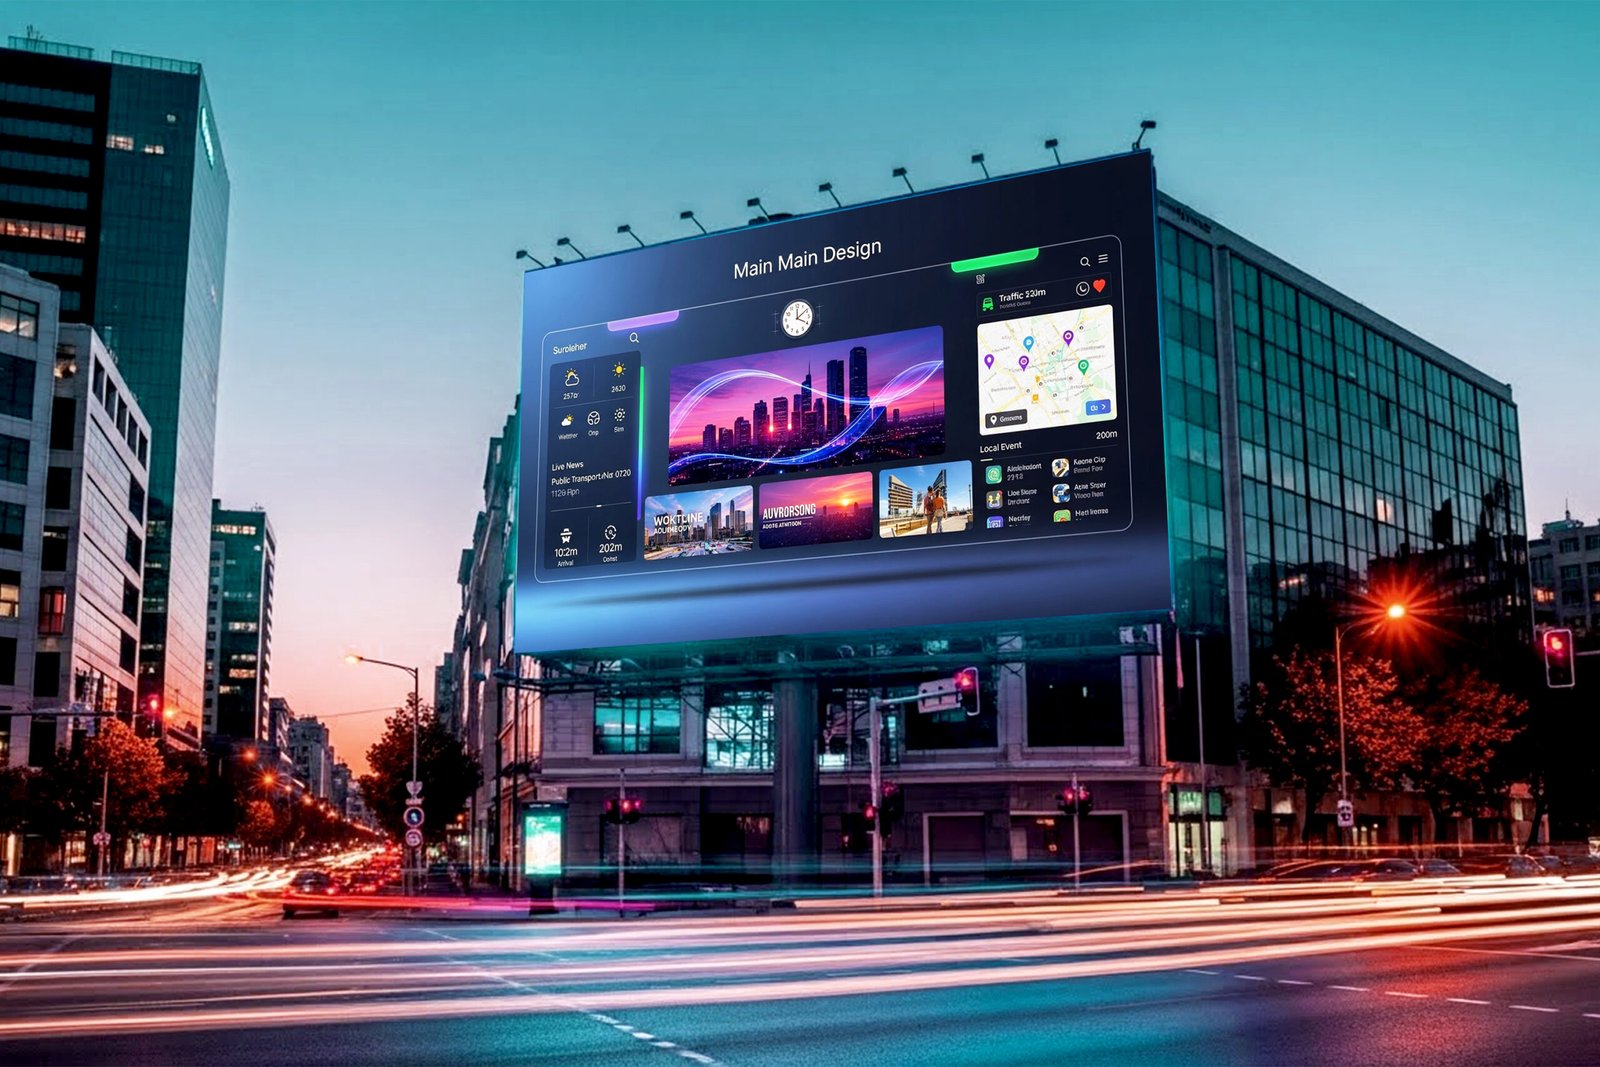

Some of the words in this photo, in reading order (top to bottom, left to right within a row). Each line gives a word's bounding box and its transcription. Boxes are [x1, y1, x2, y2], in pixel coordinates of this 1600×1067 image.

[734, 259, 773, 279] Main
[778, 251, 818, 271] Main
[823, 240, 882, 263] Design
[999, 291, 1024, 302] Traffic
[1096, 430, 1118, 440] 200m
[980, 443, 1000, 454] Local
[1000, 441, 1022, 451] Event
[551, 463, 565, 472] Live
[566, 461, 584, 470] News
[551, 476, 571, 486] Public
[598, 542, 623, 554] 202m
